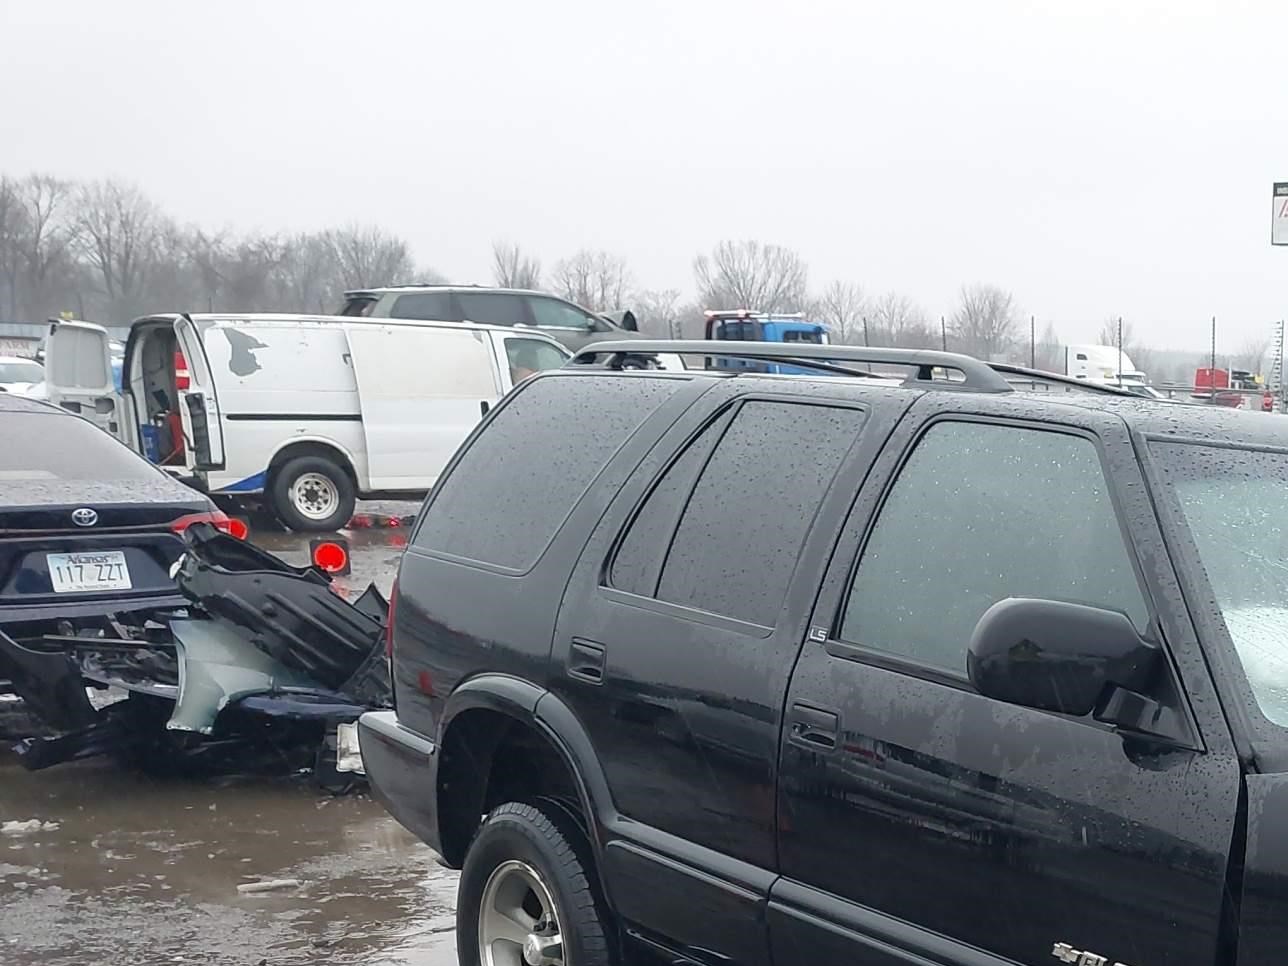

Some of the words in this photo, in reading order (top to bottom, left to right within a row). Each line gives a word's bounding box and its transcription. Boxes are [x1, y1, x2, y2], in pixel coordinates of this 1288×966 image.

[67, 555, 109, 564] Arkansas
[56, 566, 83, 583] 117
[809, 628, 827, 642] LS
